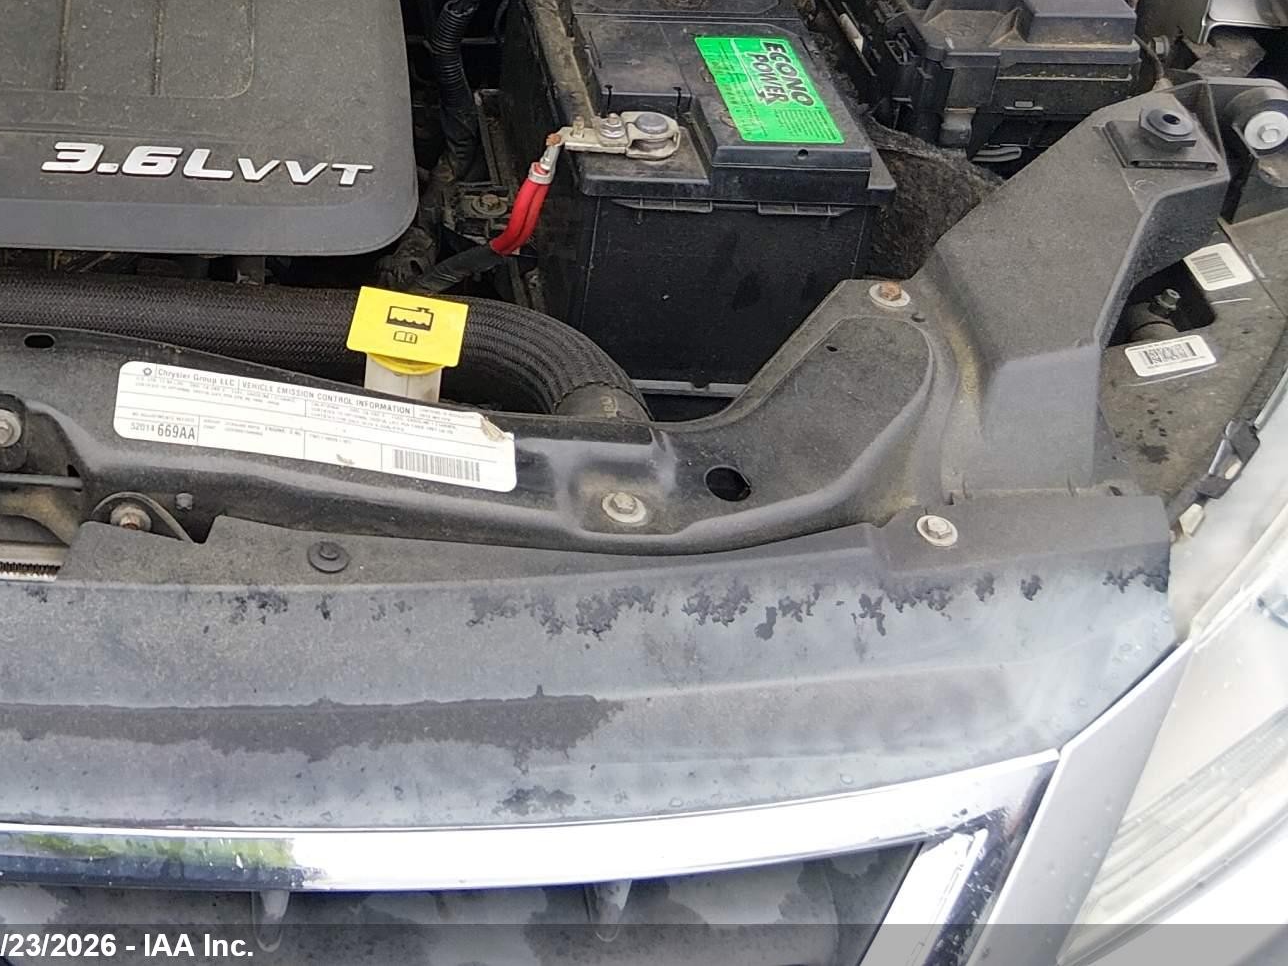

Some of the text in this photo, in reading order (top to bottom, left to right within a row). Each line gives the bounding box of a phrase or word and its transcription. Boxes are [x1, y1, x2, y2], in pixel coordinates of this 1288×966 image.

[750, 54, 789, 103] POWER
[763, 42, 815, 106] ECONO
[158, 369, 190, 380] Chrysler
[193, 374, 217, 386] Group
[220, 377, 234, 386] LLC
[242, 380, 273, 393] VEHICLE
[277, 386, 314, 398] EMISSION
[317, 393, 353, 405] CONTROL
[356, 400, 411, 414] INFORMATION
[157, 423, 195, 440] 669AA
